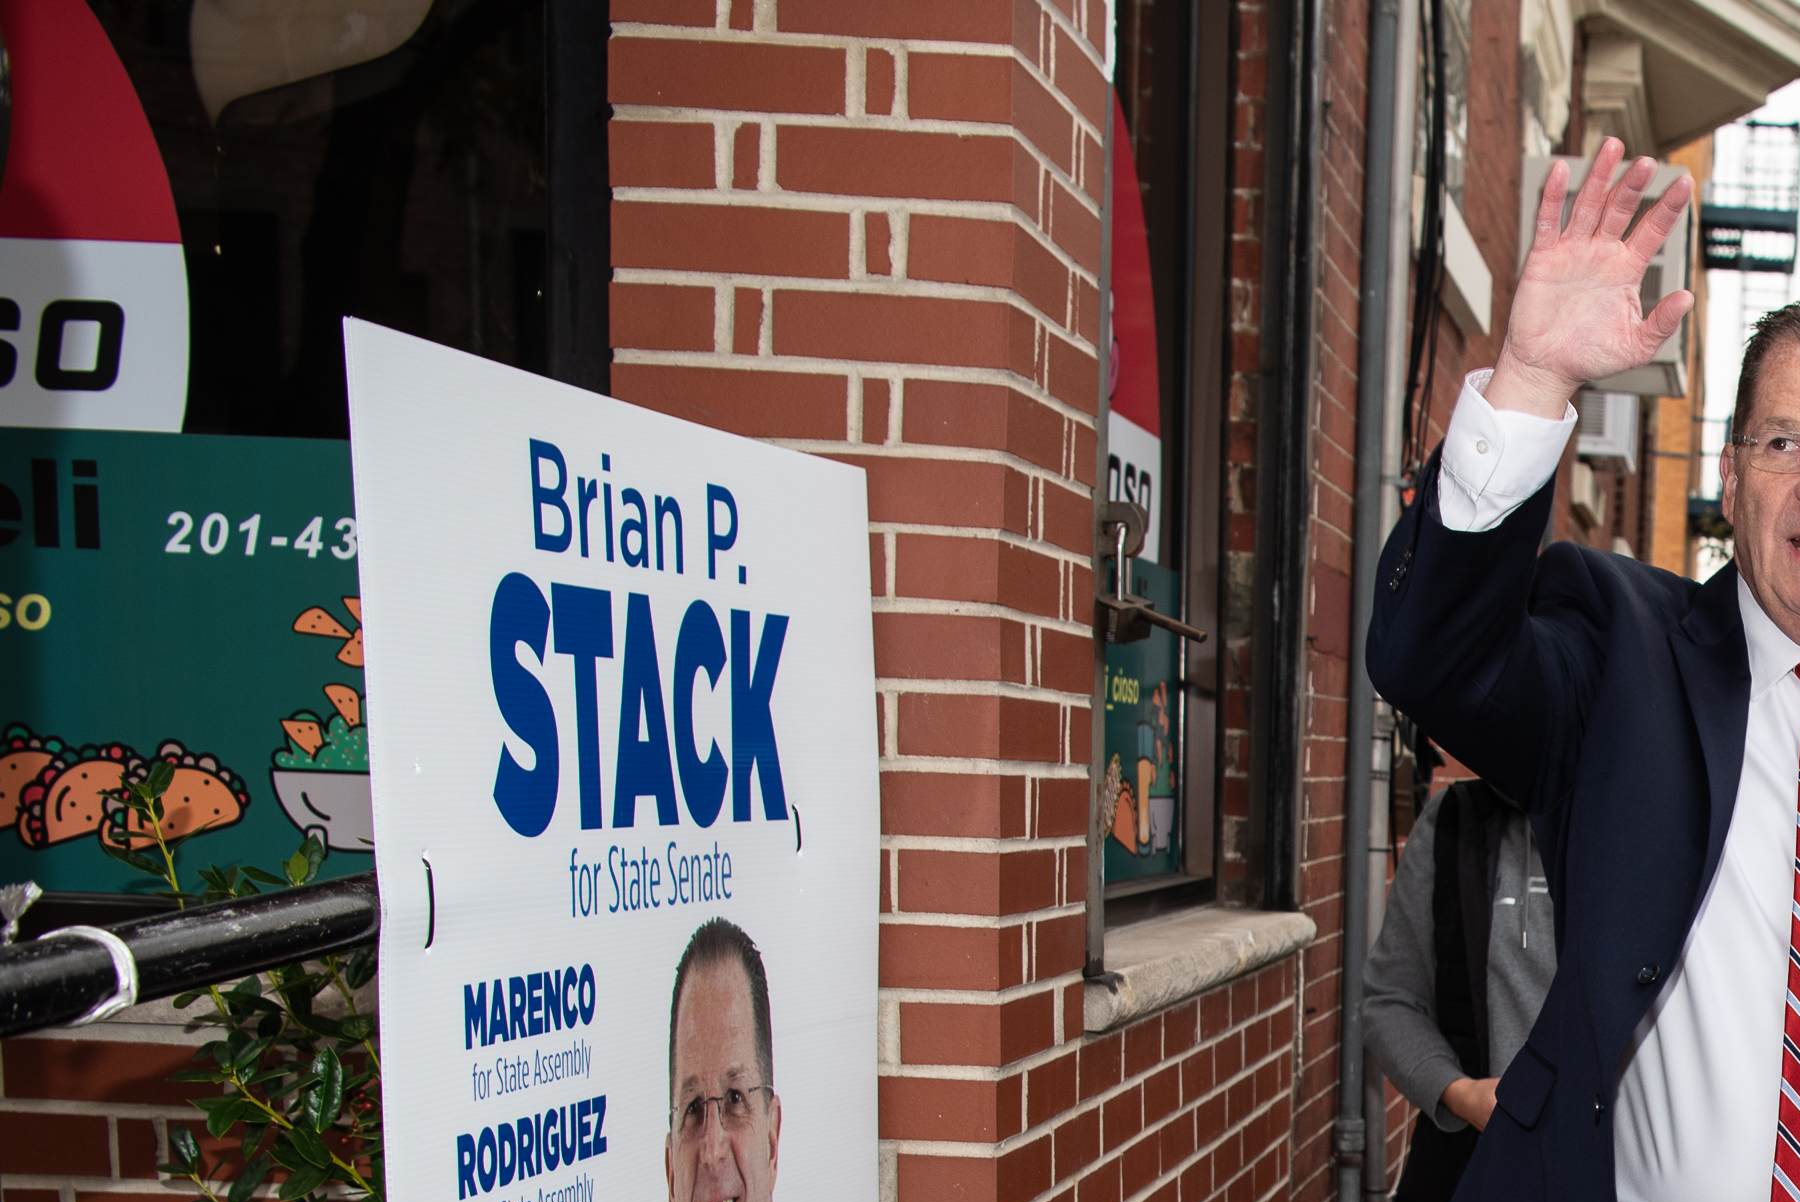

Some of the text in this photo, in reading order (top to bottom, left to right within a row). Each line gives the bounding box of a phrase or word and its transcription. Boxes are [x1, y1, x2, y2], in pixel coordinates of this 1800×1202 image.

[528, 437, 747, 585] Brian P.
[489, 571, 790, 838] STACK
[569, 840, 733, 918] for State Senate
[463, 962, 597, 1051] MARENCO
[471, 1038, 592, 1102] for State Assembly
[456, 1094, 608, 1201] RODRIGUEZ
